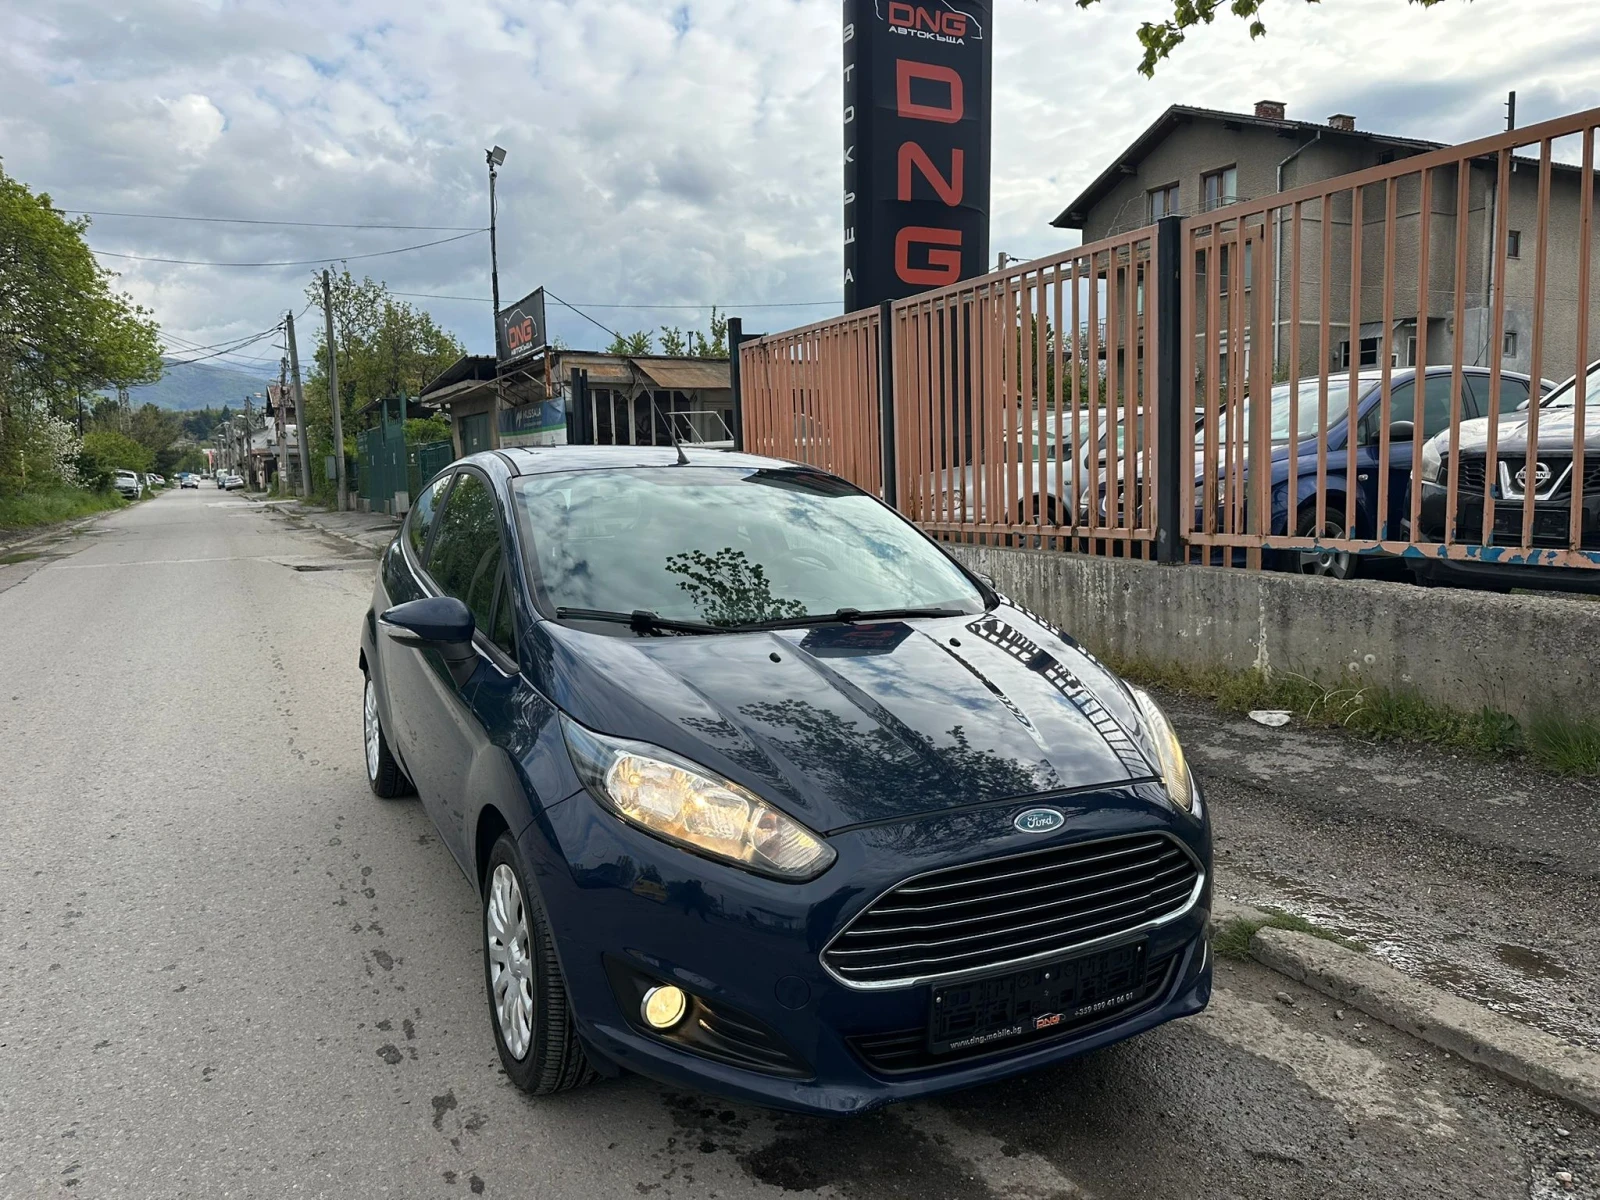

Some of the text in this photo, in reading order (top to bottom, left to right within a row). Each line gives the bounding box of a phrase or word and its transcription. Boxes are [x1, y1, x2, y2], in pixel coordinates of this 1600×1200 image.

[888, 1, 966, 37] DNG
[888, 25, 965, 45] АВТОКЪША
[843, 0, 855, 284] ВТОКЪША
[895, 58, 964, 286] DNG
[509, 319, 532, 349] DNG
[1027, 814, 1054, 828] Ford
[1074, 1005, 1092, 1016] +359
[1093, 1001, 1106, 1011] 899
[1036, 1014, 1060, 1030] DNG
[950, 1026, 1022, 1048] www.dng.mobile.bg
